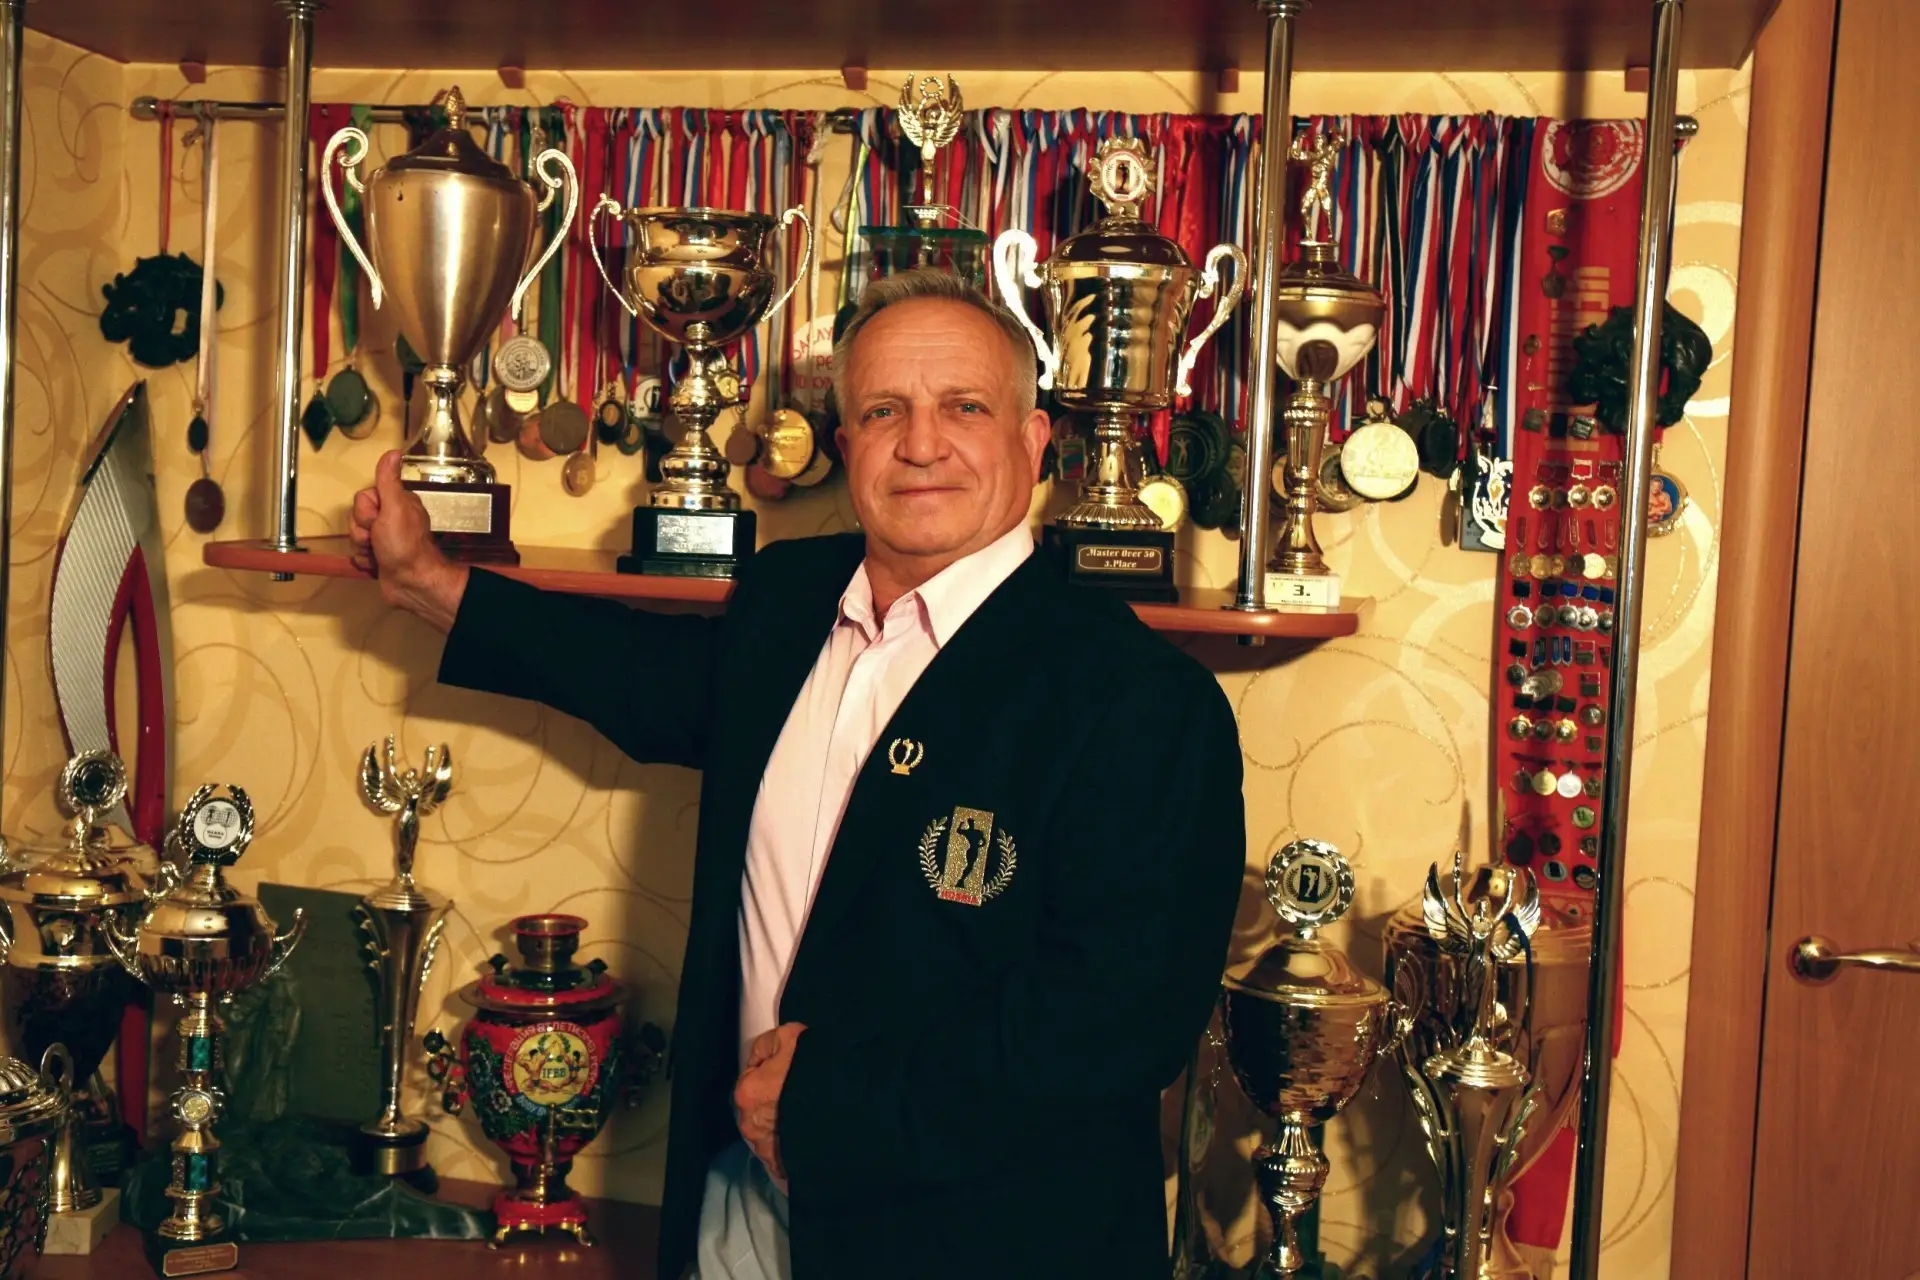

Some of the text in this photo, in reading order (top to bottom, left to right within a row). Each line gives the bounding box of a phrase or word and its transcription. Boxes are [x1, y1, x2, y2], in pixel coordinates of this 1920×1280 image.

[1086, 548, 1120, 558] Master
[1121, 549, 1142, 558] Over
[1293, 584, 1311, 597] 3.
[542, 1067, 567, 1079] IFBB
